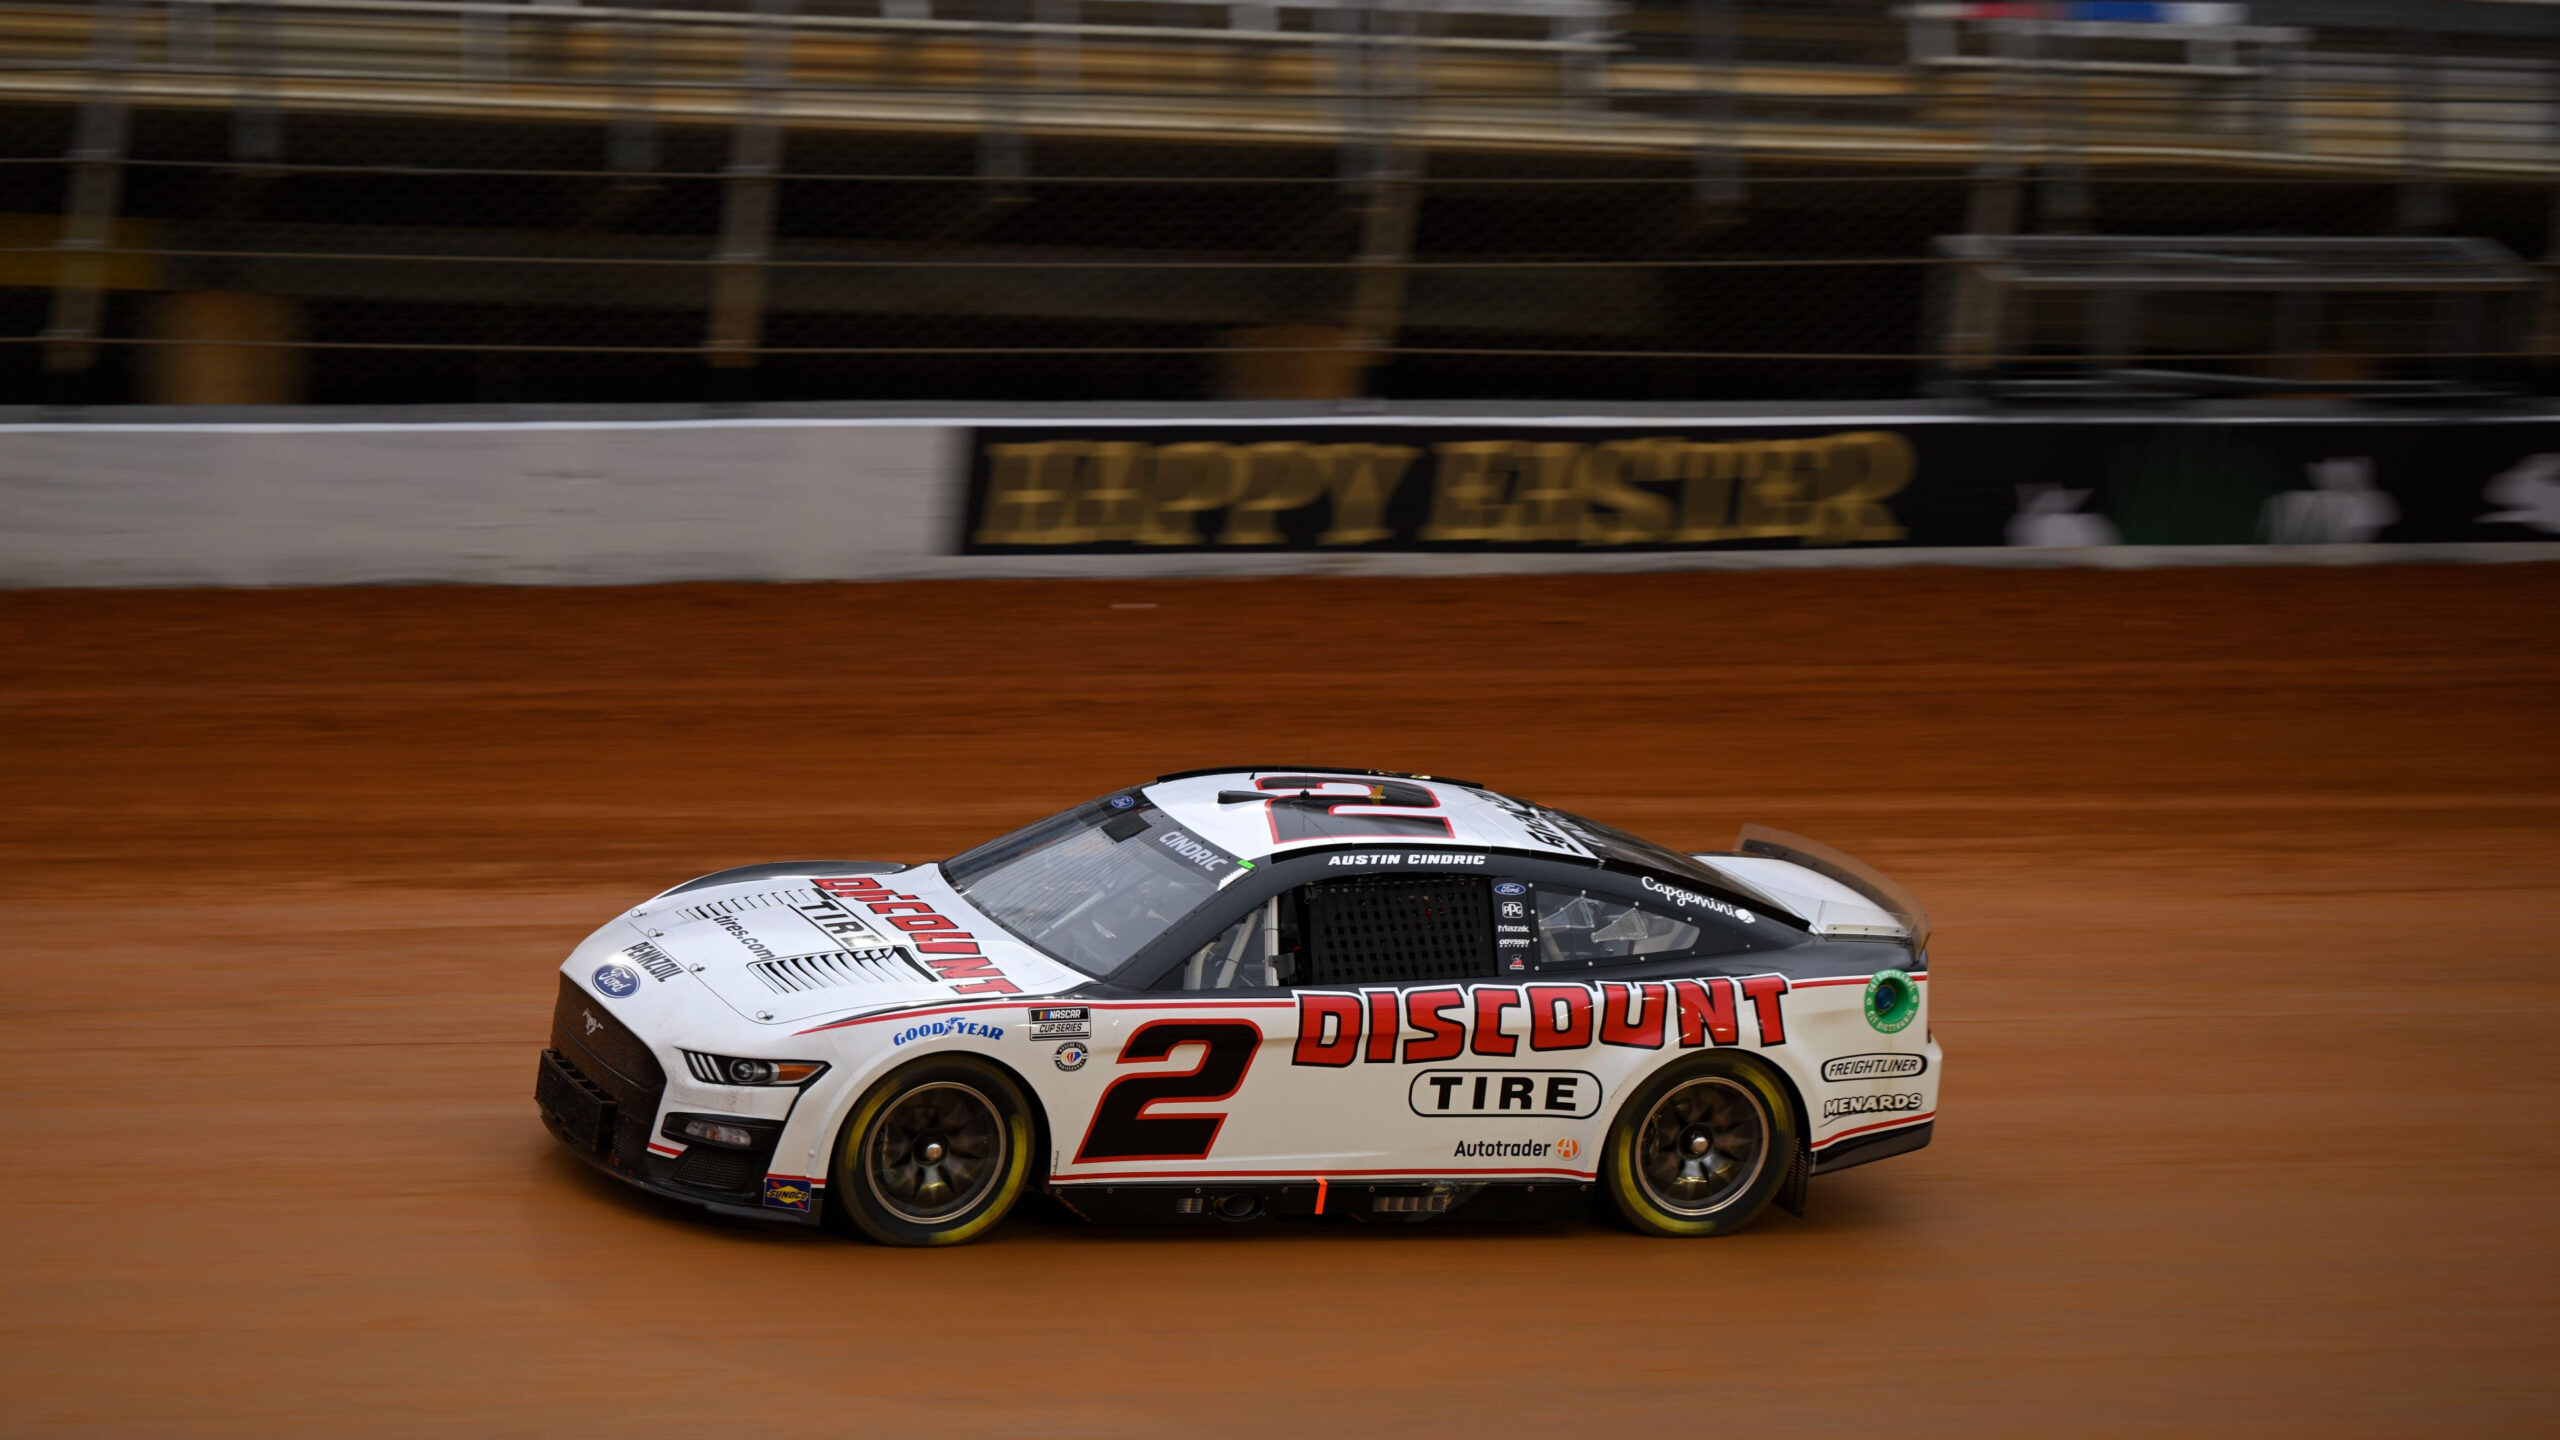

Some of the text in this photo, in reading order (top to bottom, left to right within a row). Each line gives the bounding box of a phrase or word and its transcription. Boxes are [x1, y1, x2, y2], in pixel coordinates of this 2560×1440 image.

[975, 431, 1917, 545] HAPPY EASTER
[1254, 776, 1456, 845] 2
[1160, 831, 1228, 871] CINDRIC
[1328, 854, 1486, 866] AUSTIN CINDRIC
[1503, 903, 1522, 916] PPG
[1641, 876, 1735, 918] Capgemini
[713, 915, 776, 960] tires.com
[809, 876, 1024, 996] DISCOUNT
[1497, 925, 1530, 933] Mazak
[622, 941, 684, 983] PENNZOIL
[1039, 1023, 1083, 1033] CUP SERIES
[1050, 1009, 1081, 1020] NASCAR
[1291, 973, 1791, 1068] DISCOUNT
[1829, 1059, 1918, 1077] FREIGHTLINER
[1071, 1018, 1264, 1165] 2
[1429, 1076, 1578, 1112] TIRE
[1824, 1093, 1923, 1118] MENARDS
[1454, 1139, 1552, 1157] Autotrader
[768, 1190, 809, 1200] SUNOCO
